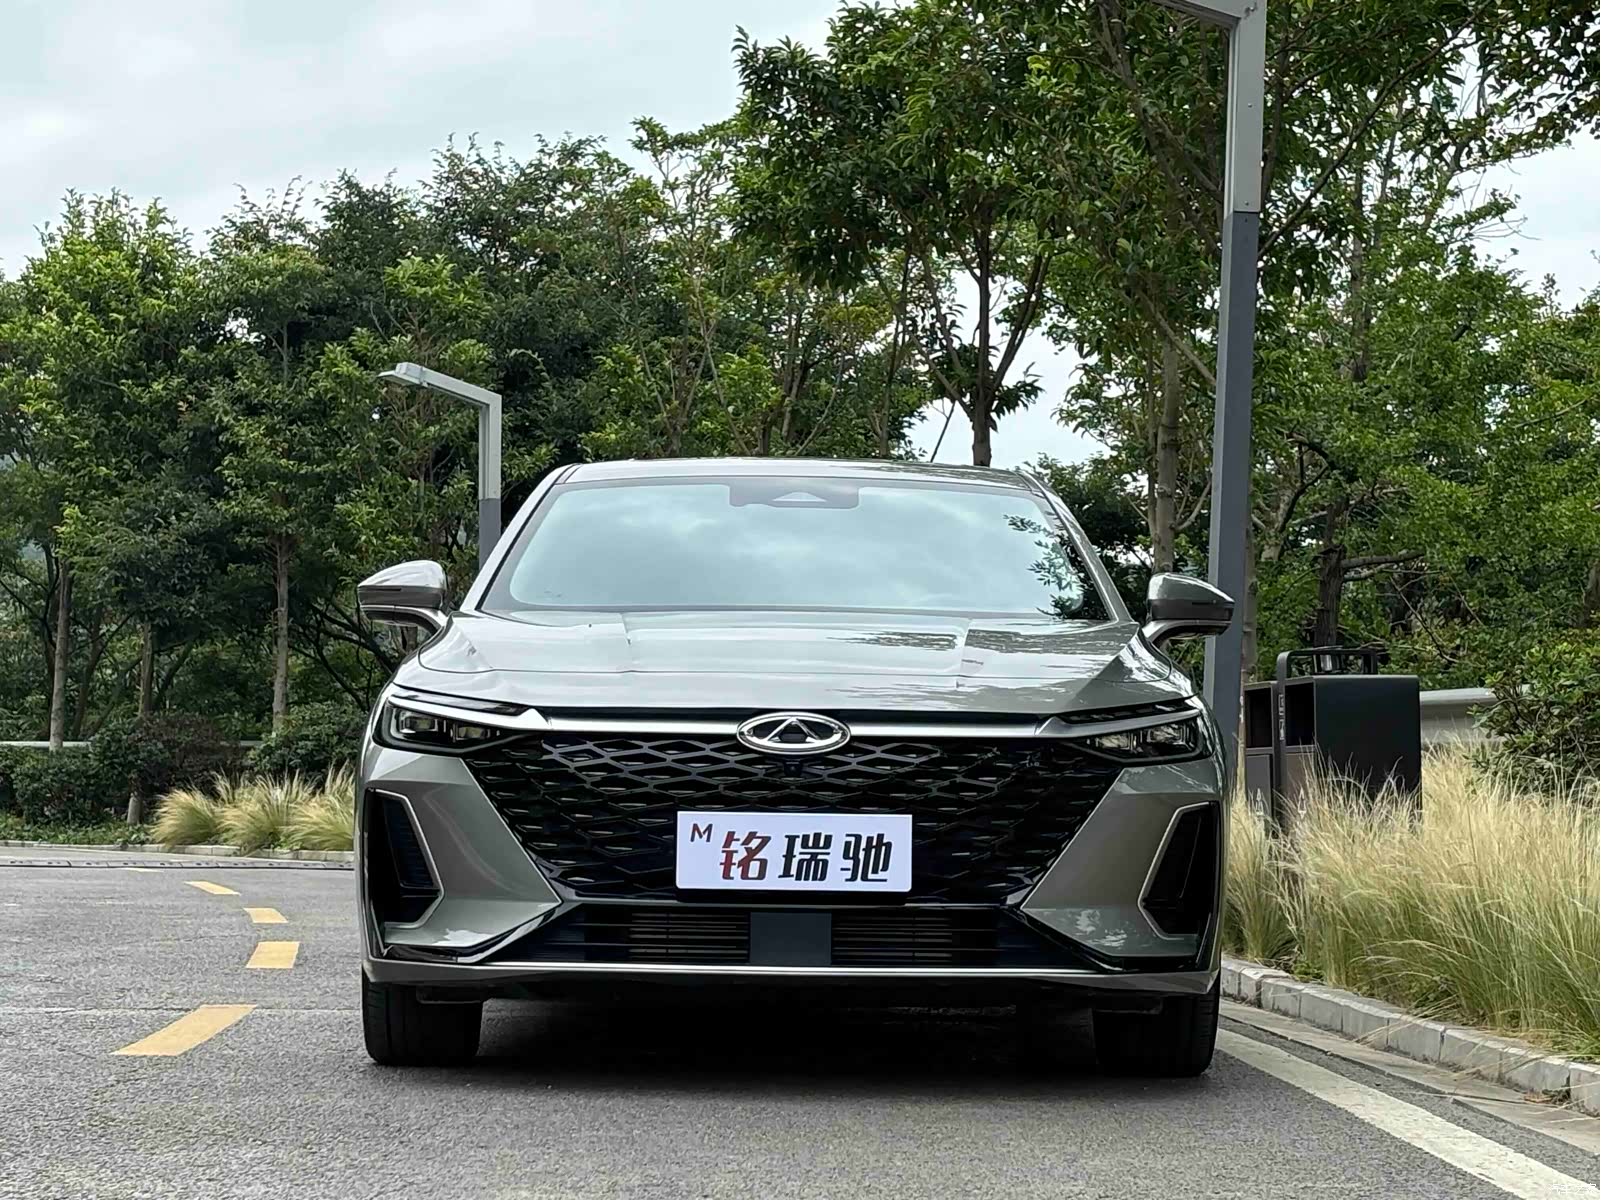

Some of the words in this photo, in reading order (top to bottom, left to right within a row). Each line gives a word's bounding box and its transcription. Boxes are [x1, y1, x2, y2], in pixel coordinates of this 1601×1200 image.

[690, 823, 713, 843] M
[719, 830, 893, 882] 铭瑞驰
